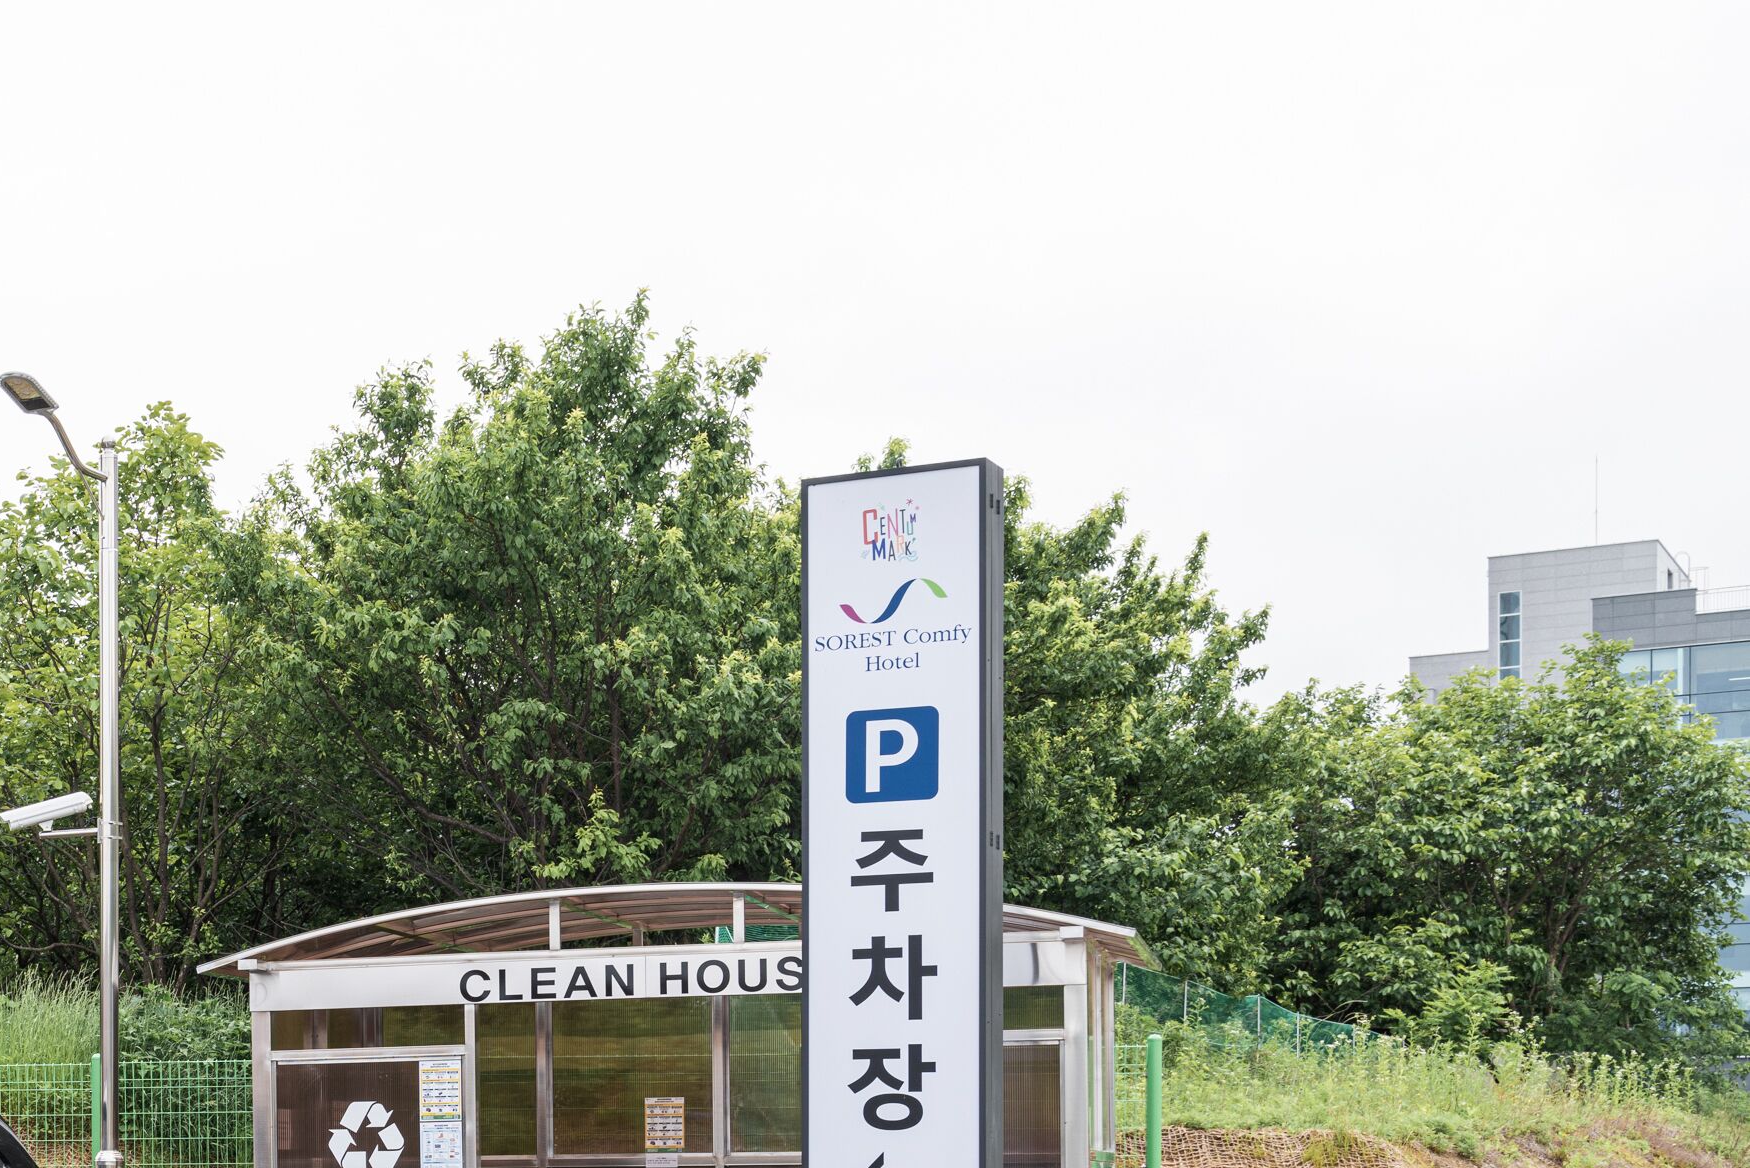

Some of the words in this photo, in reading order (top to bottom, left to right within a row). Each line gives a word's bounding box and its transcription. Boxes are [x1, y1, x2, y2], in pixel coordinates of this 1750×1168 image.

[872, 535, 912, 561] MARK
[814, 630, 897, 652] SOREST
[903, 624, 972, 644] Comfy
[865, 653, 920, 672] Hotel
[865, 718, 919, 794] P
[459, 963, 635, 1003] CLEAN
[659, 956, 803, 995] HOUS
[848, 828, 939, 1132] 주차장
